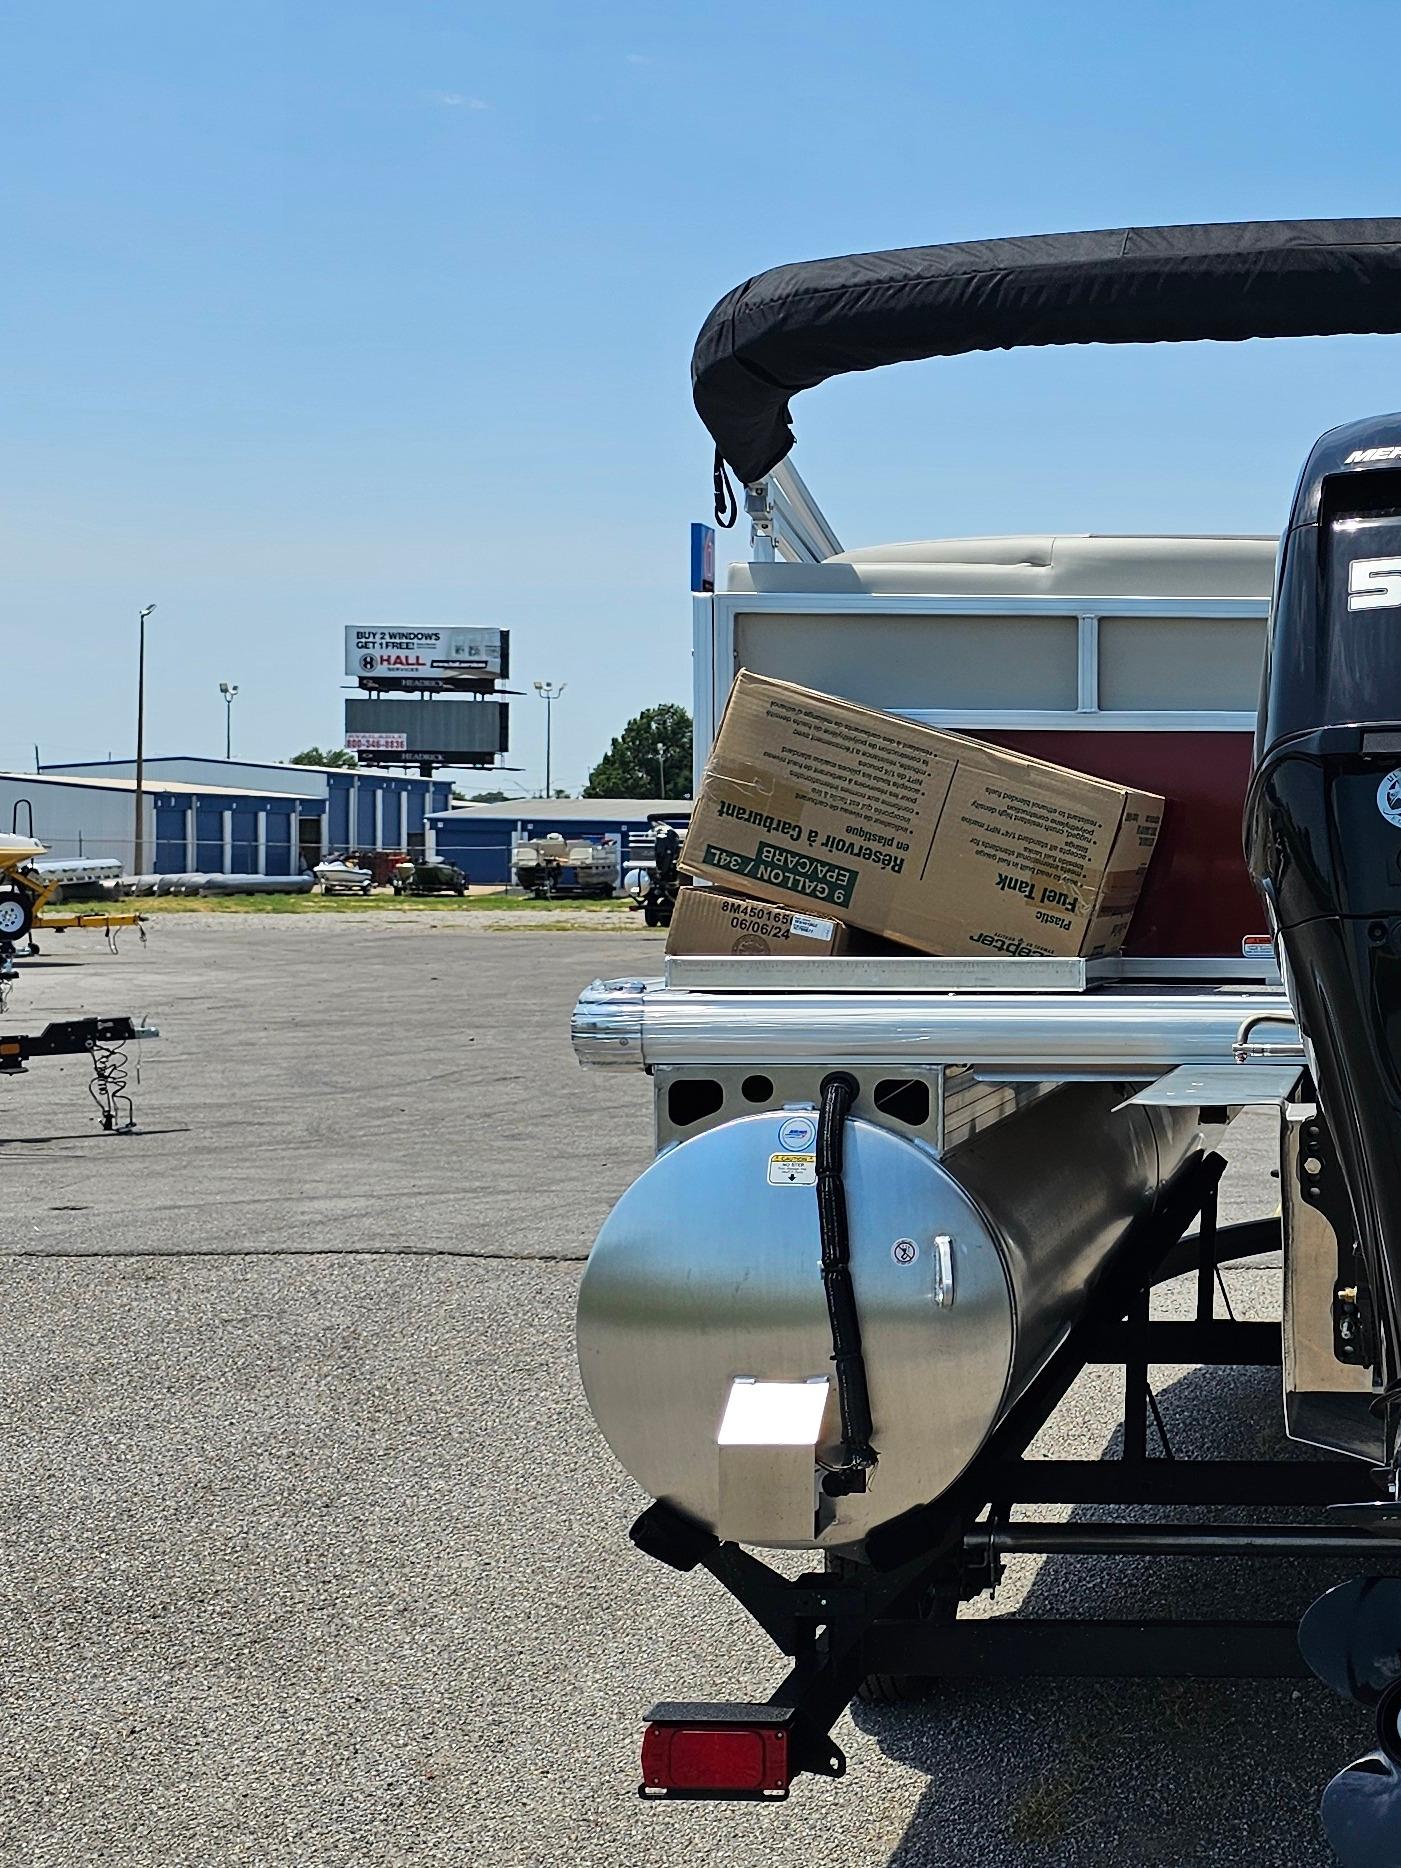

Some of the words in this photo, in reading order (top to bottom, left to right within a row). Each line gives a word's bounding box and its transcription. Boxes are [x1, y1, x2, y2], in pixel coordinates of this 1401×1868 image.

[356, 631, 378, 640] BUY
[379, 632, 386, 640] 2
[356, 642, 378, 650] GET
[385, 642, 415, 650] FREE!
[380, 655, 426, 666] HALL
[984, 786, 1002, 798] fuels
[1002, 792, 1031, 806] blended
[970, 799, 997, 814] density
[997, 808, 1014, 819] high
[1005, 804, 1049, 823] construction
[1030, 801, 1057, 814] ethanol
[1057, 809, 1066, 817] to
[715, 800, 804, 842] Carburant
[960, 815, 985, 828] marine
[1013, 813, 1043, 829] resistant
[1049, 816, 1094, 836] polyethylene
[1066, 812, 1097, 827] resistant
[844, 822, 895, 848] plastique
[984, 823, 1001, 834] NPT
[1043, 823, 1064, 835] crush
[804, 828, 819, 847] à
[969, 836, 981, 846] for
[1016, 833, 1048, 849] standard
[895, 840, 910, 851] en
[980, 840, 1016, 857] standards
[1022, 846, 1043, 858] tanks
[1048, 843, 1058, 852] all
[707, 847, 742, 870] 34L
[819, 833, 905, 875] Réservoir
[974, 848, 997, 861] gauge
[1043, 852, 1057, 862] fuel
[1058, 846, 1087, 860] accepts
[760, 845, 850, 885] EPA/CARB
[996, 856, 1011, 866] fuel
[1011, 860, 1019, 868] in
[1015, 851, 1059, 870] international
[1057, 856, 1084, 870] topside
[1018, 862, 1036, 874] built
[1035, 868, 1052, 879] read
[1059, 865, 1082, 877] meets
[756, 863, 830, 898] GALLON
[1052, 873, 1061, 881] to
[993, 872, 1039, 900] Tank
[832, 887, 846, 903] 9
[1039, 886, 1079, 913] Fuel
[722, 901, 793, 926] 8M450165
[1033, 910, 1072, 931] Plastic
[730, 917, 790, 940] 06/06/24
[968, 932, 1052, 957] cepter
